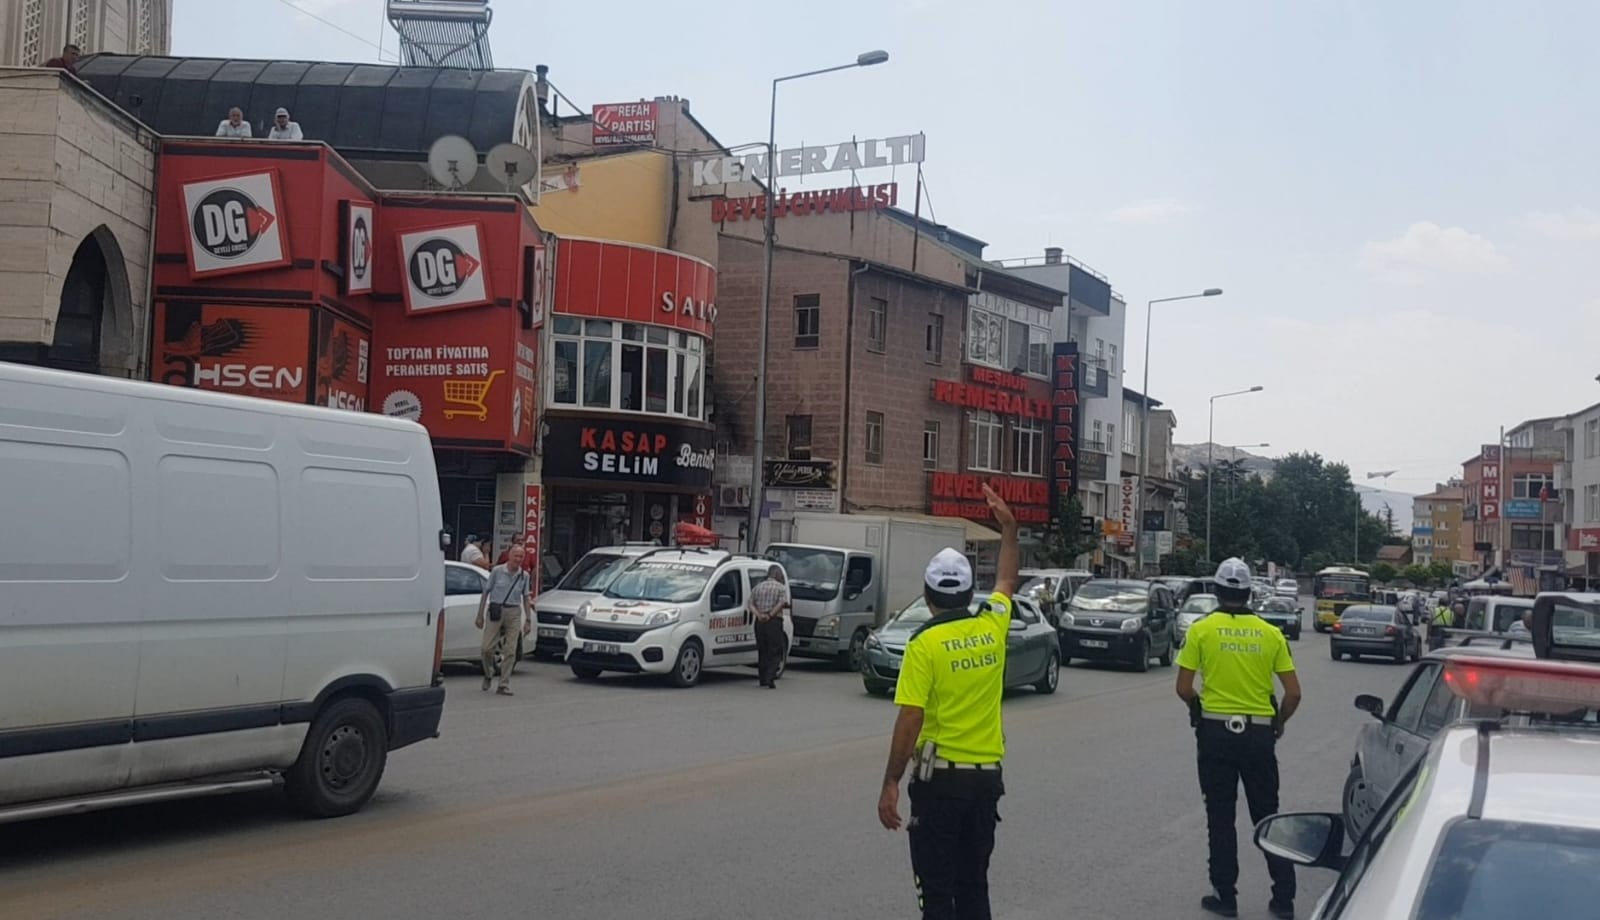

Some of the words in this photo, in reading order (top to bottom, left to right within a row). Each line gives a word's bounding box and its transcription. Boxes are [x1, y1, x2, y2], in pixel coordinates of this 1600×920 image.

[618, 104, 650, 117] REFAH
[692, 134, 926, 187] KEMERALTI
[202, 200, 248, 247] DG
[416, 248, 457, 288] DG
[386, 347, 432, 360] TOPTAN
[436, 345, 489, 360] FİYATINA
[386, 363, 453, 376] PERAKENDE
[456, 362, 489, 376] SATIŞ
[933, 379, 1052, 420] KEMERALTI
[580, 427, 667, 456] KASAP
[1483, 466, 1497, 516] MHP
[941, 632, 996, 652] TRAFİK
[1216, 627, 1264, 638] TRAFİK
